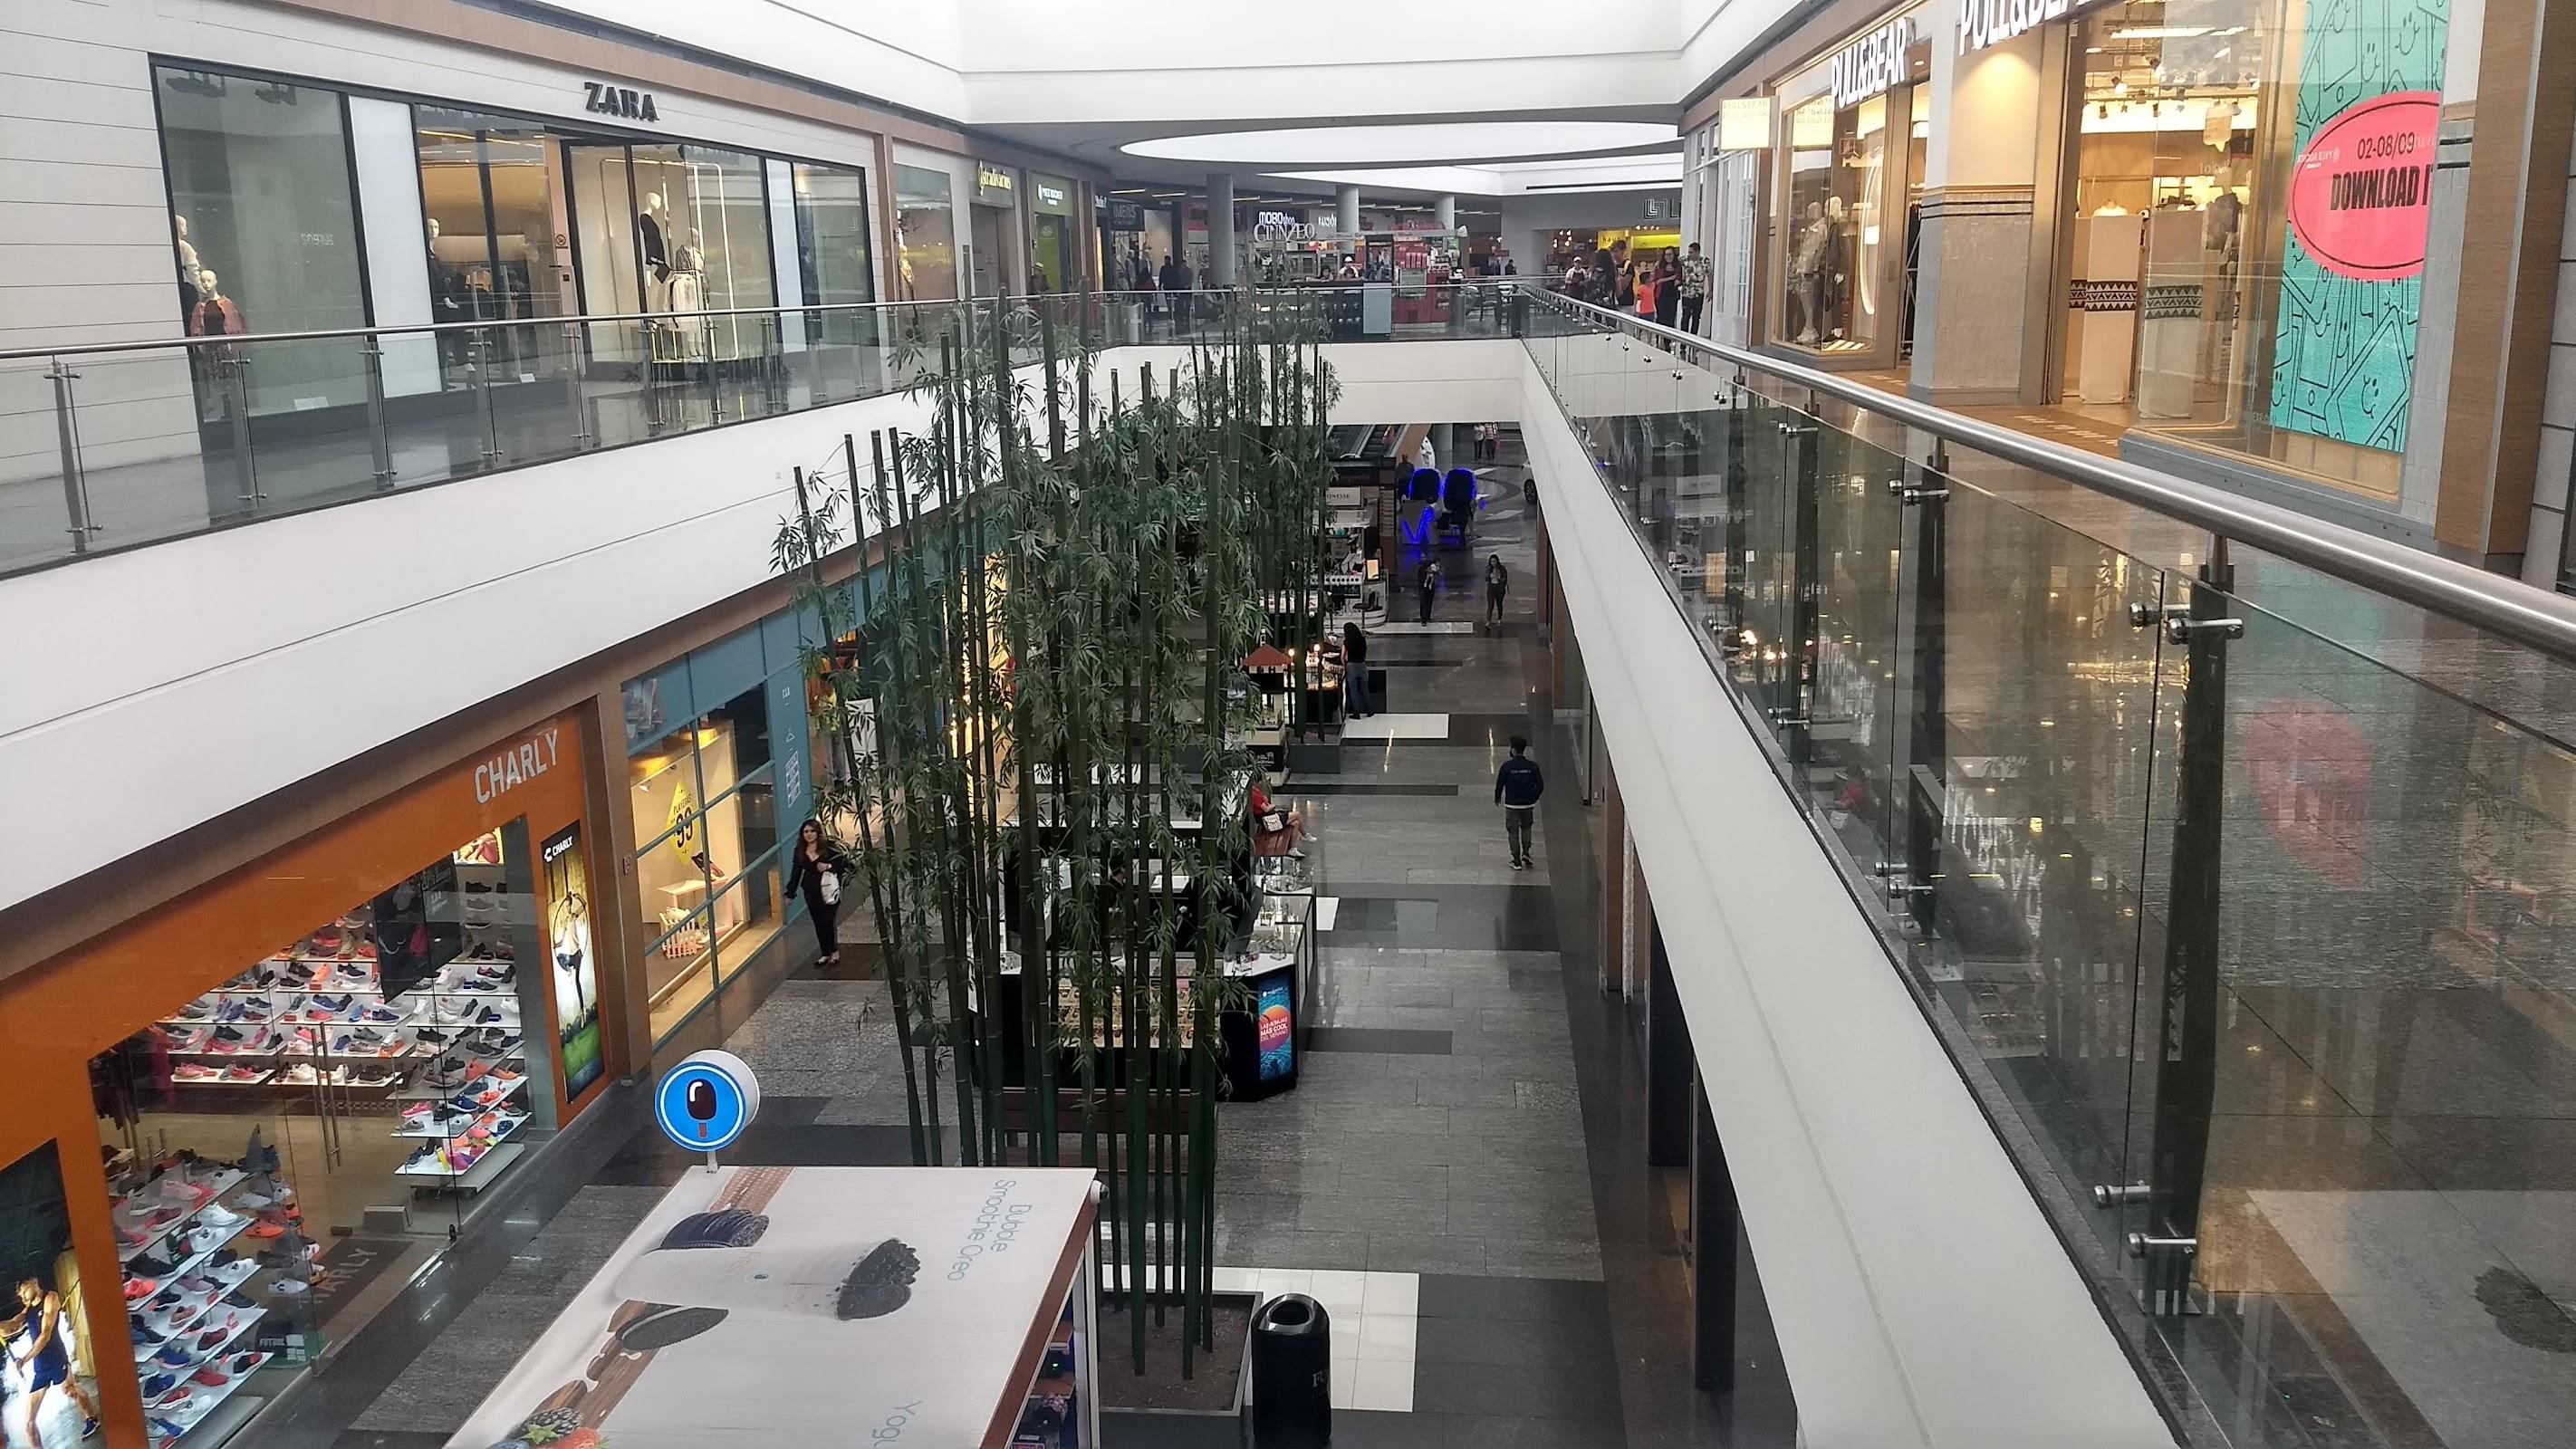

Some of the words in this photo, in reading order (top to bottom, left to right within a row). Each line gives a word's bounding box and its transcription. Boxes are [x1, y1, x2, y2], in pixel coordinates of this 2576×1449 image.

[1831, 17, 1907, 109] PULL&BEAR
[584, 82, 660, 122] ZARA
[2357, 131, 2416, 160] 02-08/09
[2330, 166, 2420, 210] DOWNLOAD
[475, 728, 558, 804] CHARLY
[552, 835, 573, 857] CHARLY
[967, 1180, 1016, 1241] Smoothie
[990, 1204, 1032, 1252] Bubble
[947, 1244, 983, 1281] Oreo
